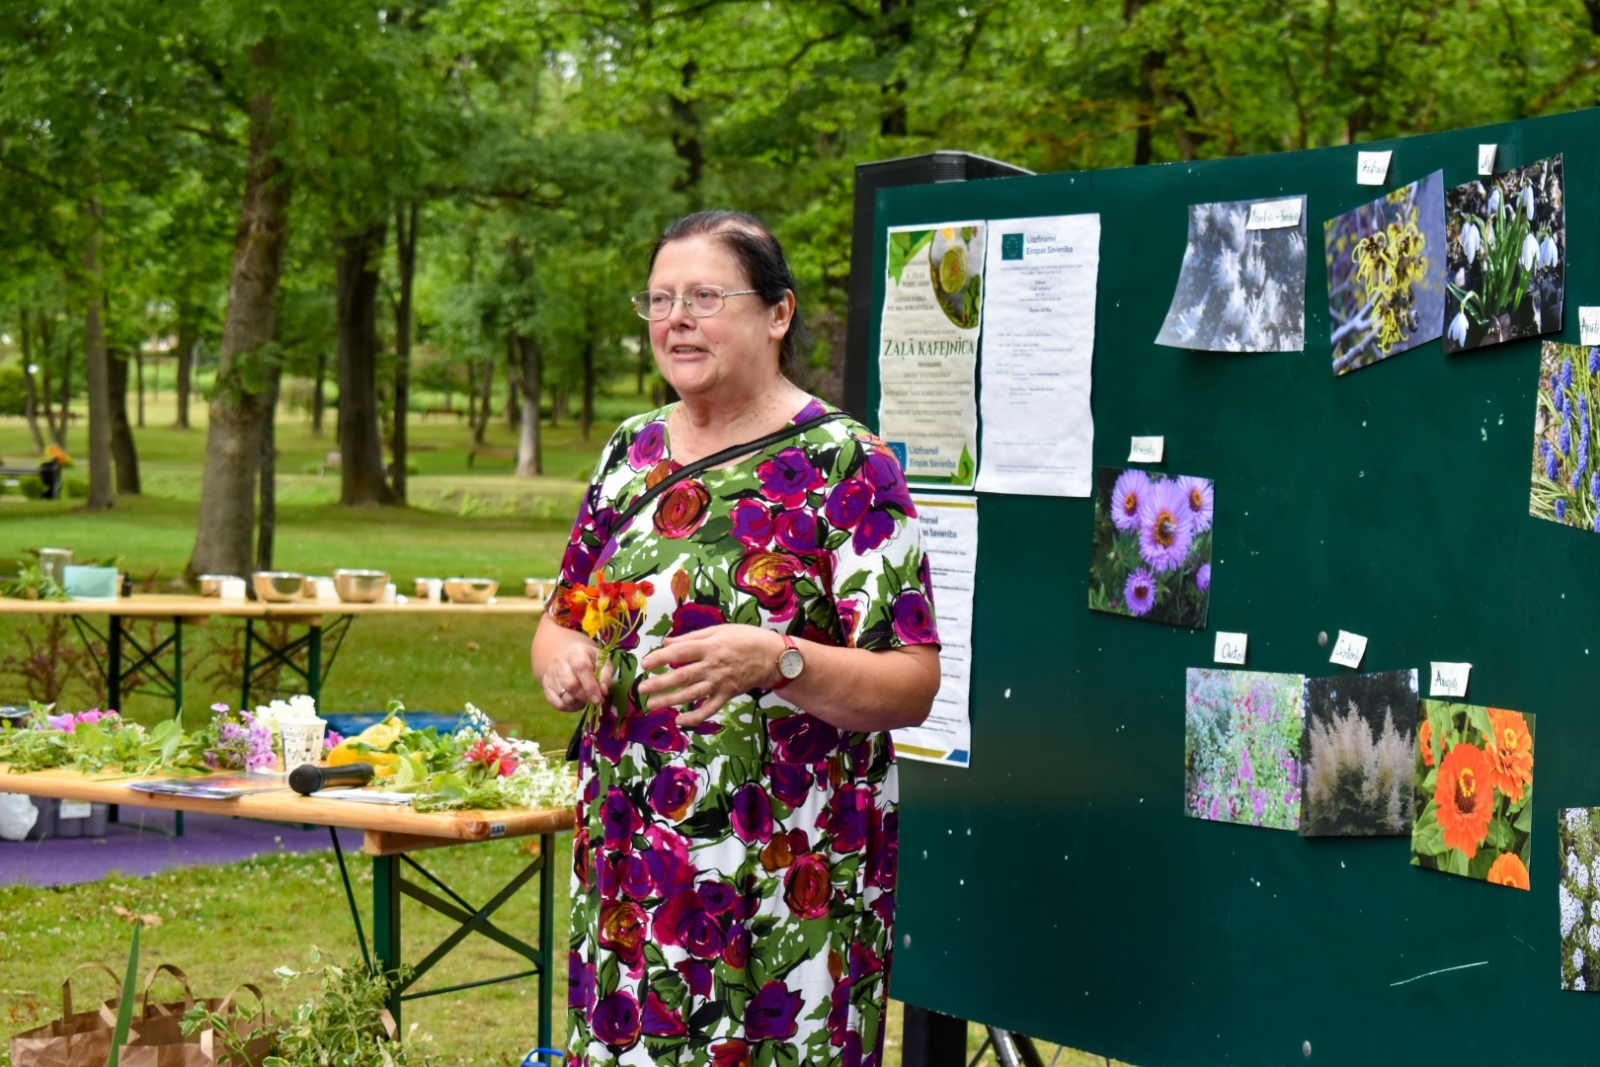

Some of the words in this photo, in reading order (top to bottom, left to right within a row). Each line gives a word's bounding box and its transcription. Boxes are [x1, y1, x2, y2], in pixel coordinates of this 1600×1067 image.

[1026, 247, 1046, 256] Eiropas
[1047, 246, 1074, 254] Savienība
[883, 337, 915, 361] ZAĻĀ
[917, 336, 975, 359] KAFEJNĪCA
[909, 459, 929, 469] Eiropas
[929, 459, 957, 470] Savienība
